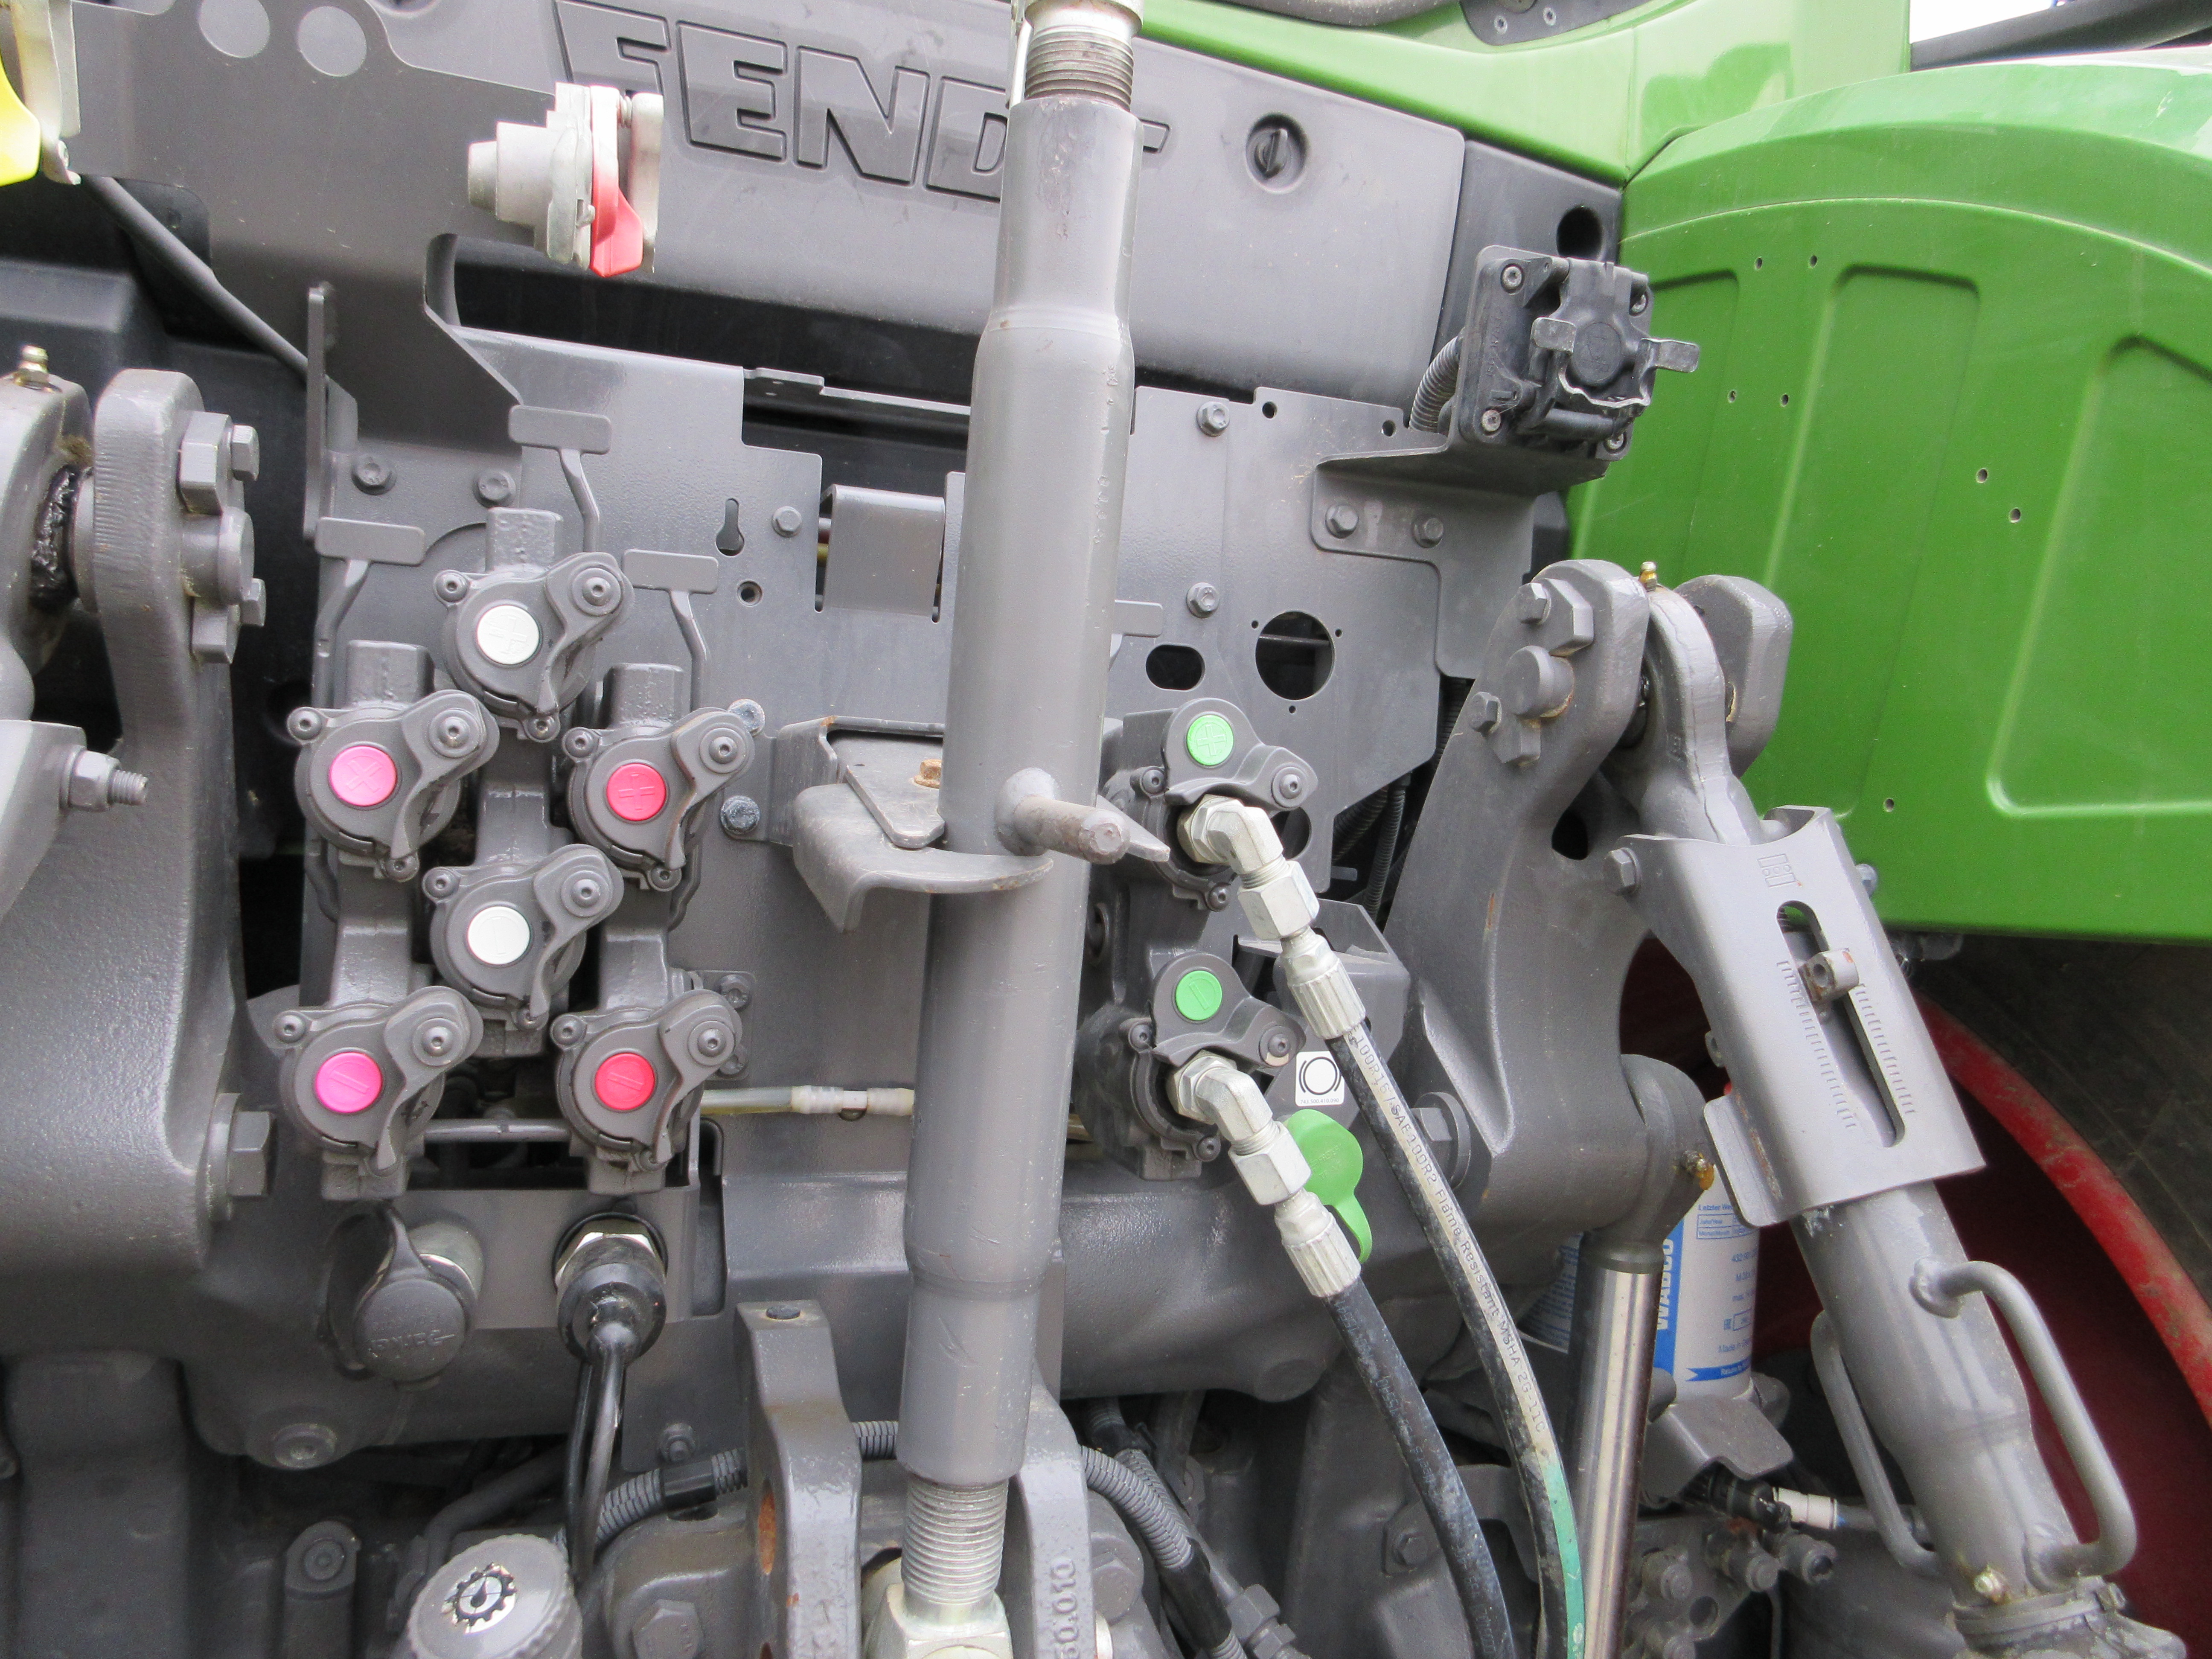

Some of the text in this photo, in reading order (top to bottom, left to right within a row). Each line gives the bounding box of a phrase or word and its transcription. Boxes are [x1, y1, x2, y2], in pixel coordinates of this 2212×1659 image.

[554, 0, 1171, 203] FEND
[1391, 1104, 1412, 1134] SAE
[1406, 1135, 1437, 1185] 100R2
[1435, 1189, 1461, 1236] Flame
[1460, 1240, 1499, 1317] Resistant
[1497, 1320, 1520, 1367] MSHA
